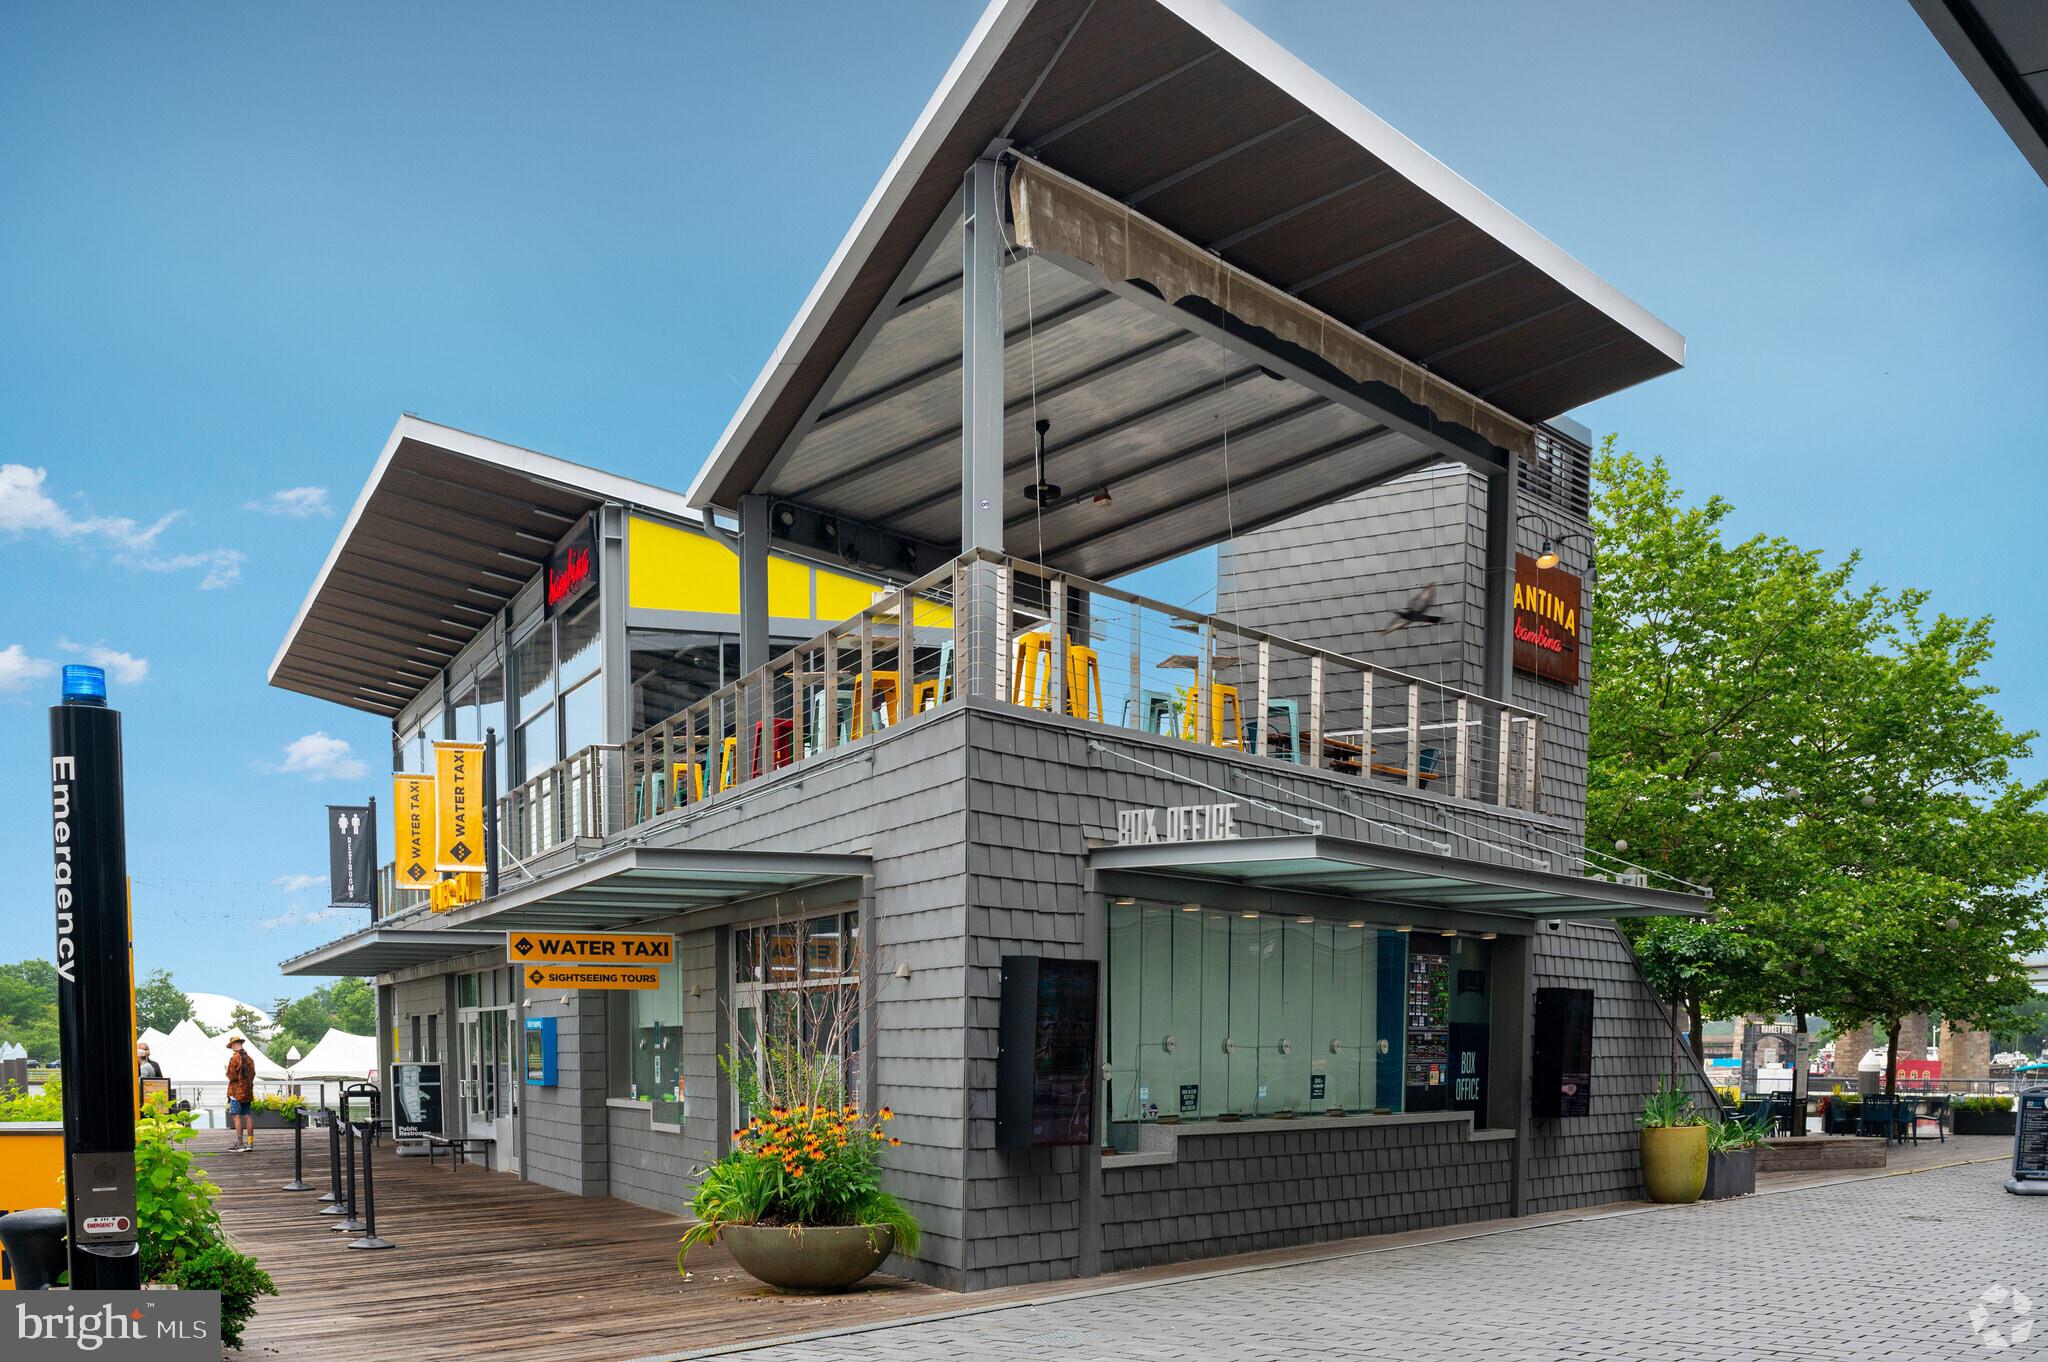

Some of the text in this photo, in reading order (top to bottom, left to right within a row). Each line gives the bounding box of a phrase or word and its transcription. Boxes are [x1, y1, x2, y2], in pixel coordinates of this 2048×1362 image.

[1513, 582, 1576, 637] ANTINA
[1514, 617, 1563, 653] bambina
[454, 750, 465, 838] WATER TAXI
[410, 781, 421, 859] WATER TAXI
[1118, 803, 1240, 845] BOX OFFICE
[52, 756, 76, 983] Emergency
[538, 939, 669, 957] WATER TAXI
[548, 973, 657, 983] SIGHTSEEING TOURS
[1461, 1051, 1476, 1074] BOX
[1455, 1078, 1480, 1101] OFFICE
